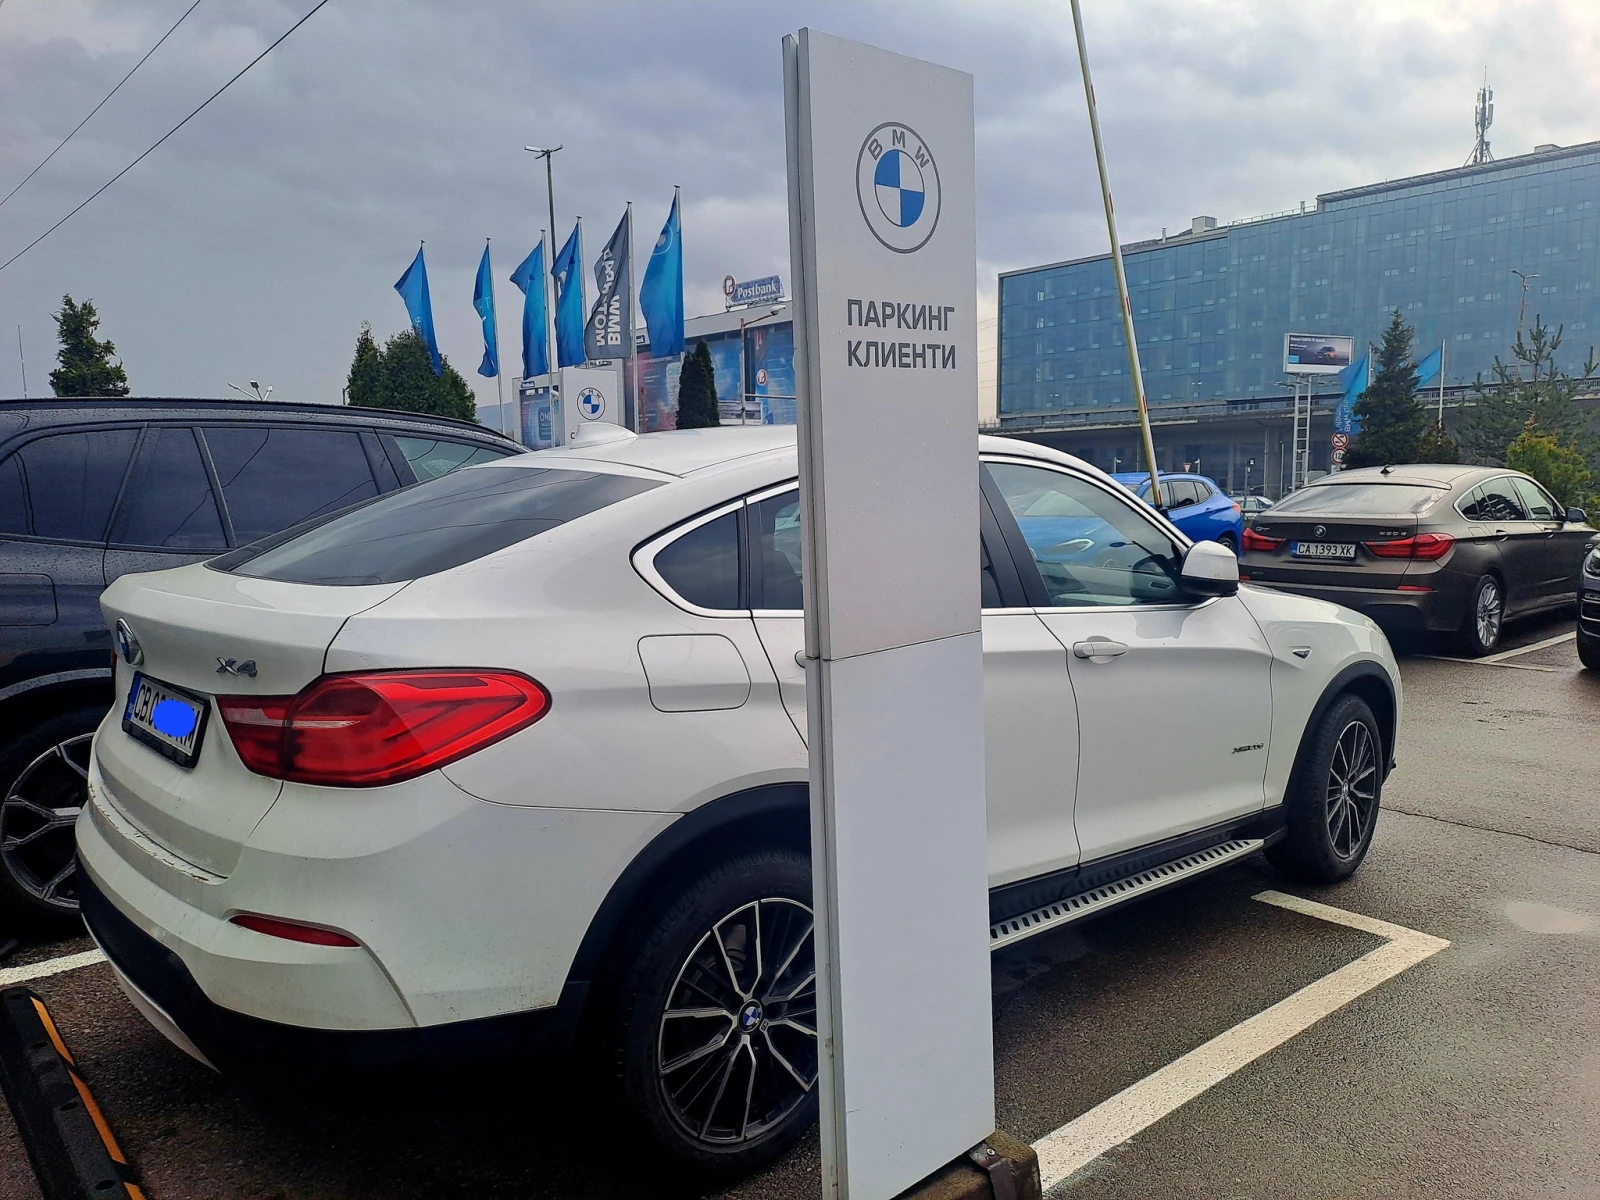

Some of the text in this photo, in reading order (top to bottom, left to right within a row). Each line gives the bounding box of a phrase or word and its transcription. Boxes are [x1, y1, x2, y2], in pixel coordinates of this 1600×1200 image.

[867, 128, 931, 169] BMW
[737, 280, 778, 299] Postbank
[847, 298, 955, 332] ПАРКИНГ
[847, 340, 957, 370] КЛИЕНТИ
[215, 656, 258, 678] X4
